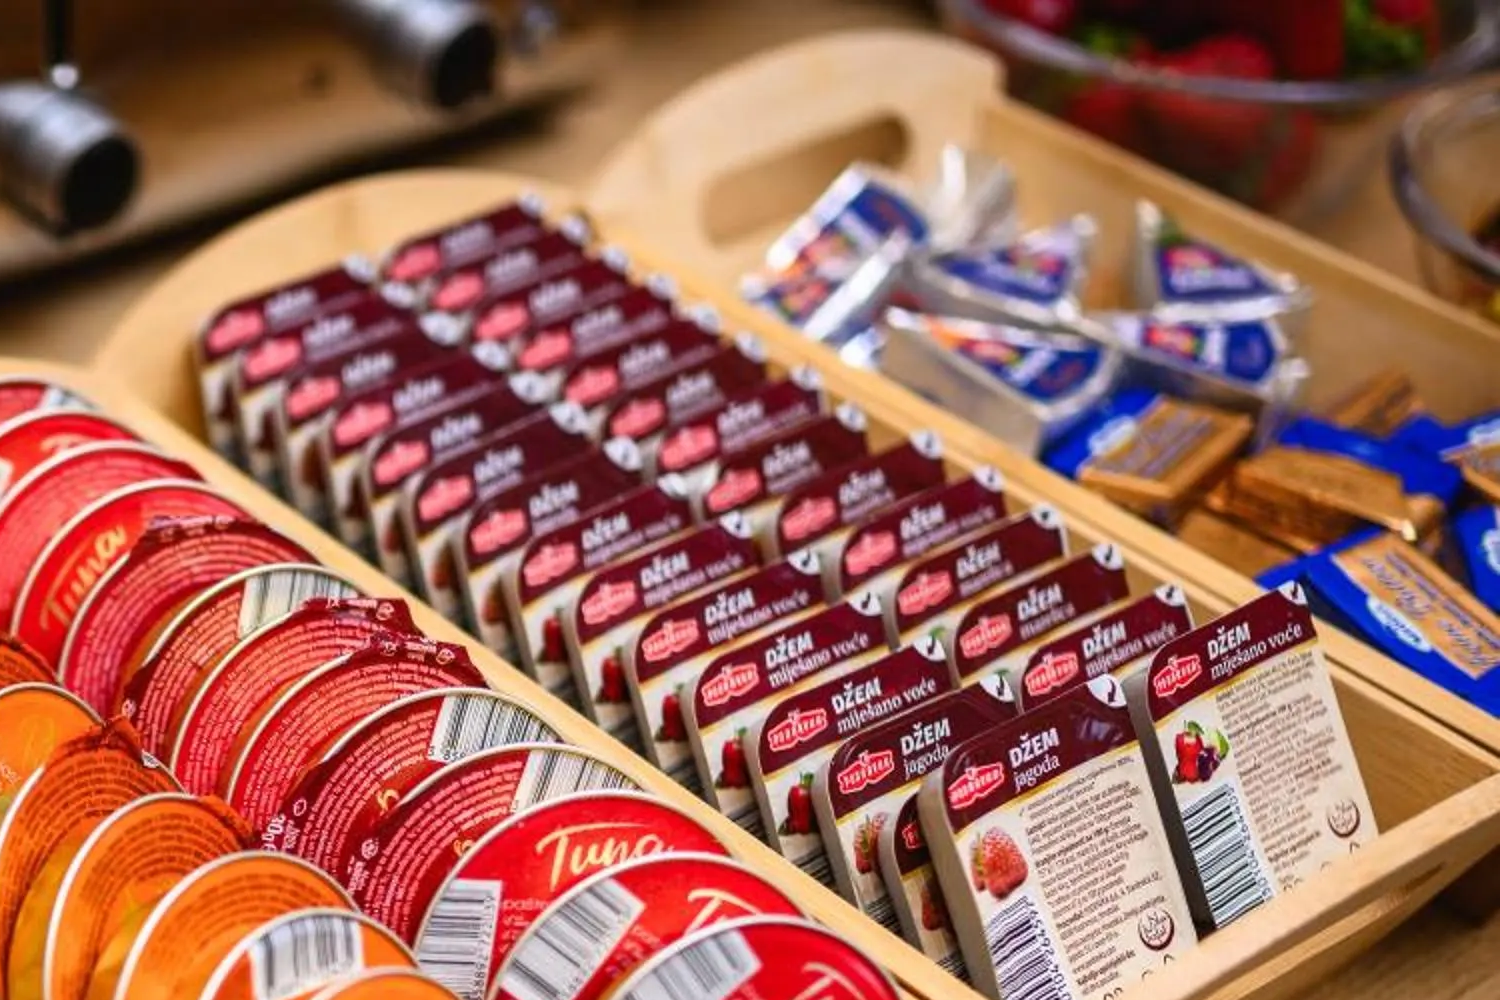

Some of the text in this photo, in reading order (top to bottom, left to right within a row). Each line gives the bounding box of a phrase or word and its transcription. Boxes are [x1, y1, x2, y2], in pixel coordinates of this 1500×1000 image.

[703, 588, 756, 627] DŽEM
[764, 631, 814, 670] DŽEM
[1081, 620, 1127, 659] DŽEM
[1207, 621, 1251, 660] DŽEM
[1210, 621, 1303, 681] miješano voće
[767, 630, 870, 689] miješano voće
[831, 676, 883, 714] DŽEM
[836, 676, 938, 735] miješano voće
[900, 718, 951, 756] DŽEM
[1008, 727, 1060, 768] DŽEM
[902, 743, 950, 781] jagoda
[1012, 754, 1061, 794] jagoda
[535, 821, 676, 893] Tuna
